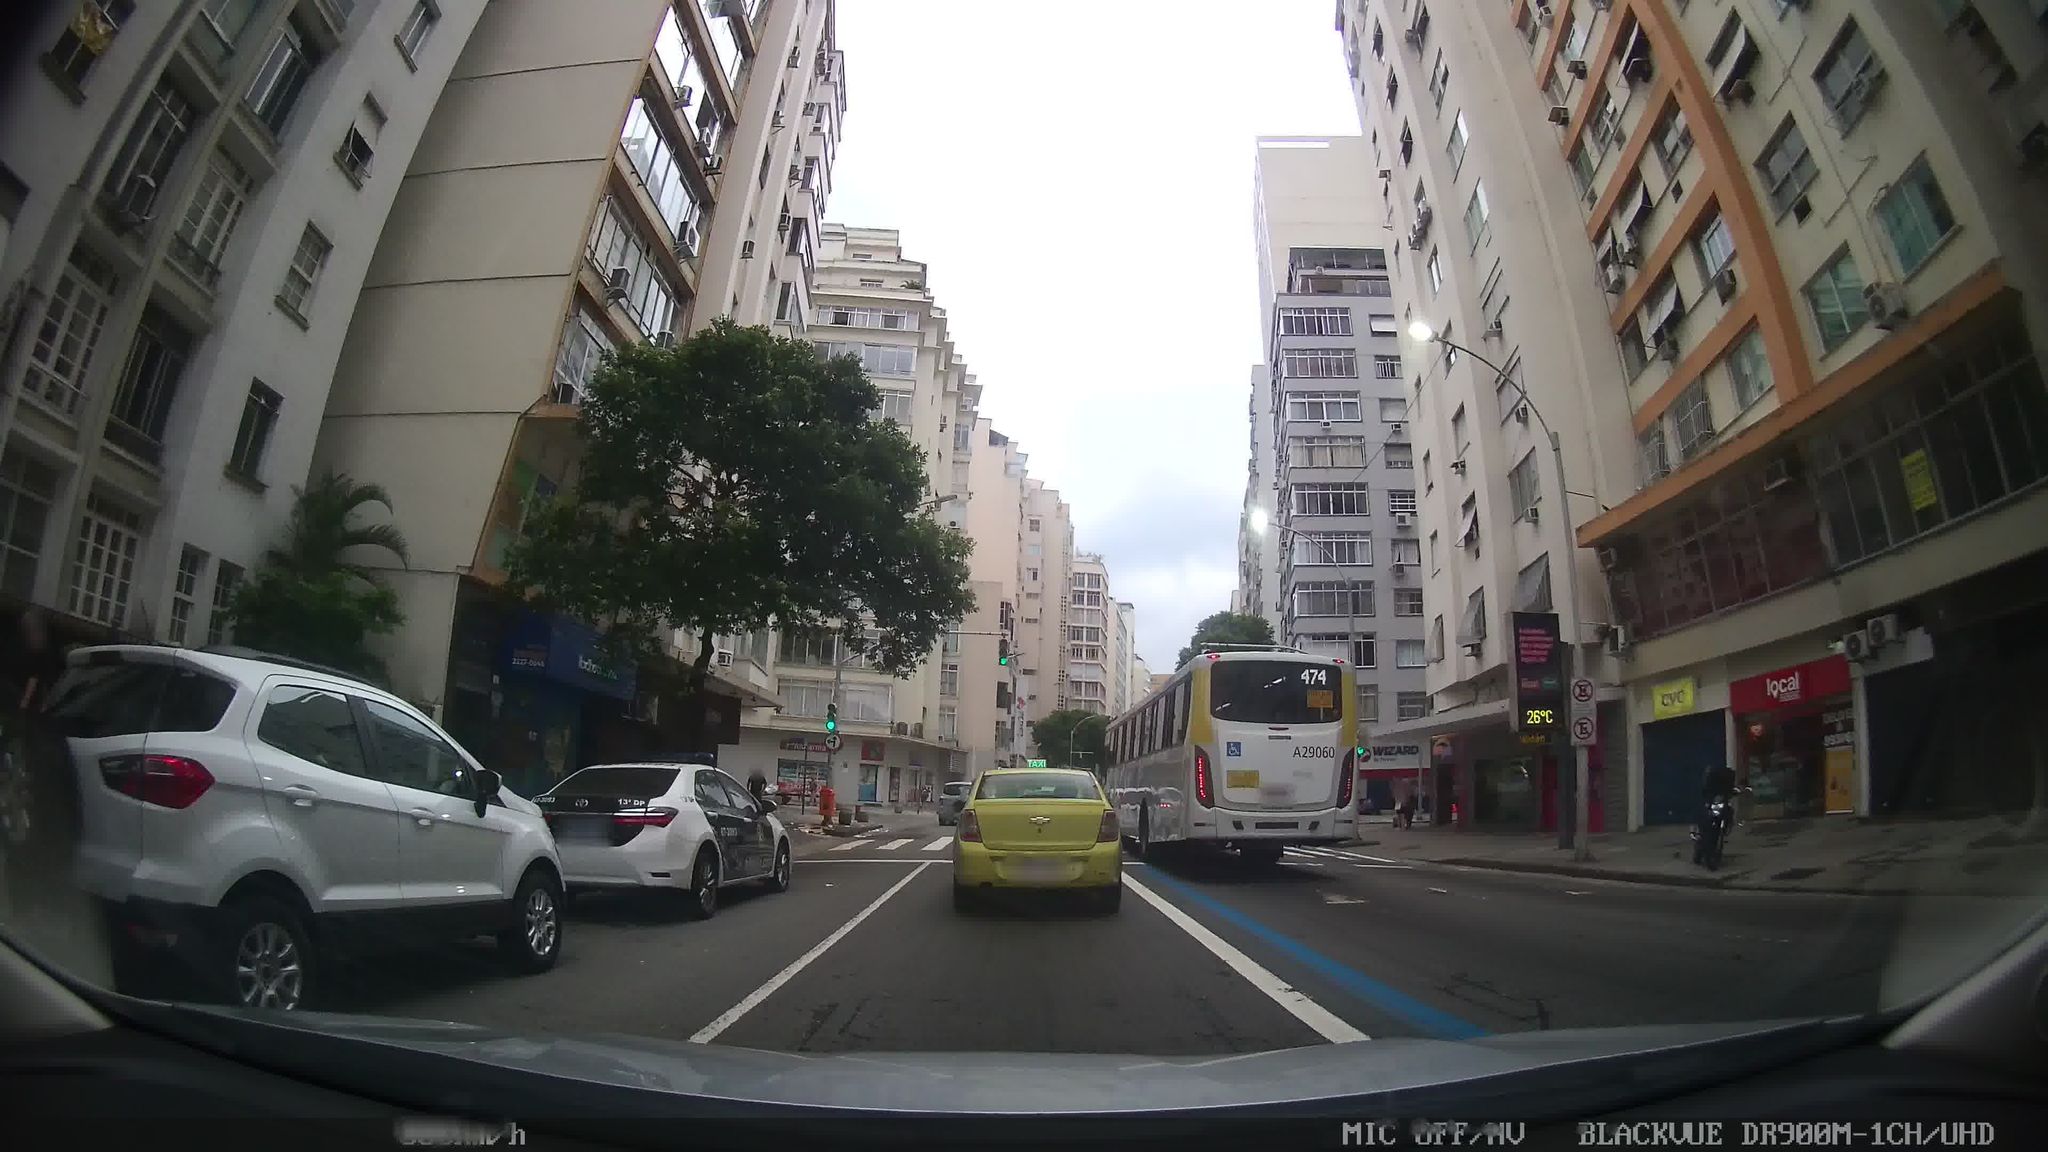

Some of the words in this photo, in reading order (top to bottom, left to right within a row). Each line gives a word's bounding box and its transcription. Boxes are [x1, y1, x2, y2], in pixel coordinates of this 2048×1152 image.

[1300, 668, 1327, 685] 474
[1766, 670, 1800, 699] local
[1526, 709, 1554, 724] 26°C
[1292, 746, 1336, 759] A29060
[1372, 745, 1420, 756] WIZARD
[1027, 759, 1047, 768] TAXI
[632, 799, 646, 807] DP
